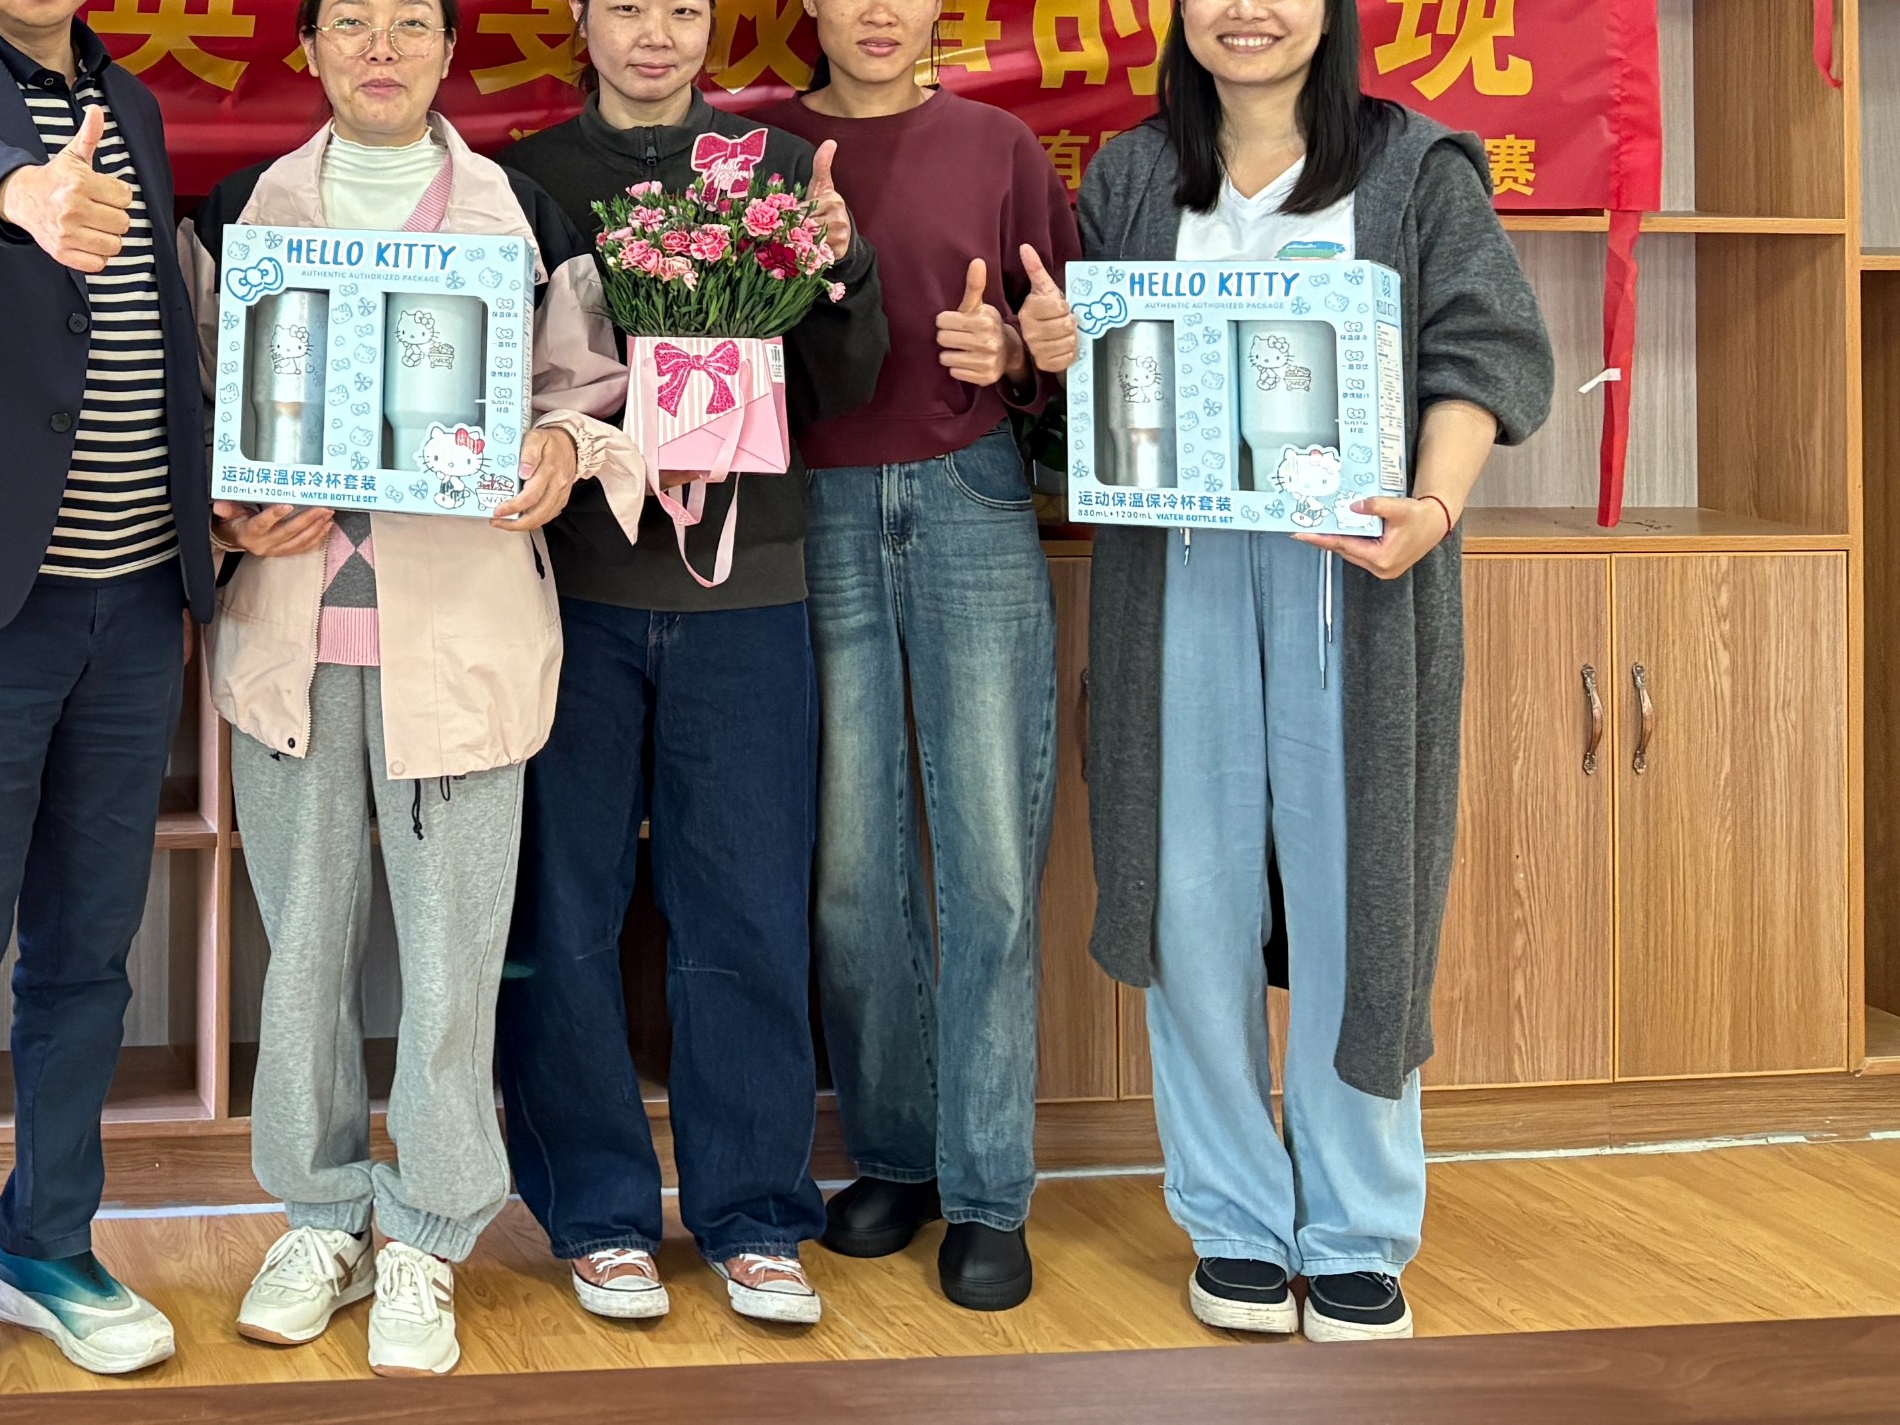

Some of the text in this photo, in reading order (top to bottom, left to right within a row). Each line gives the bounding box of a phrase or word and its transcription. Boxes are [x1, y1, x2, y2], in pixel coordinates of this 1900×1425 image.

[286, 238, 457, 271] HELLO KITTY
[300, 270, 441, 283] AUTHENTIC AUTHORIZED PACKAGE
[1129, 271, 1301, 297] HELLO KITTY
[1246, 302, 1285, 310] PACKAGE
[221, 465, 377, 491] 运动保温保冷杯套装
[300, 491, 328, 500] WATER
[330, 492, 361, 502] BOTTLE
[1078, 490, 1232, 512] 运动保温保冷杯套装
[1156, 513, 1184, 522] WATER
[1186, 514, 1217, 523] BOTTLE
[1219, 515, 1234, 524] SET
